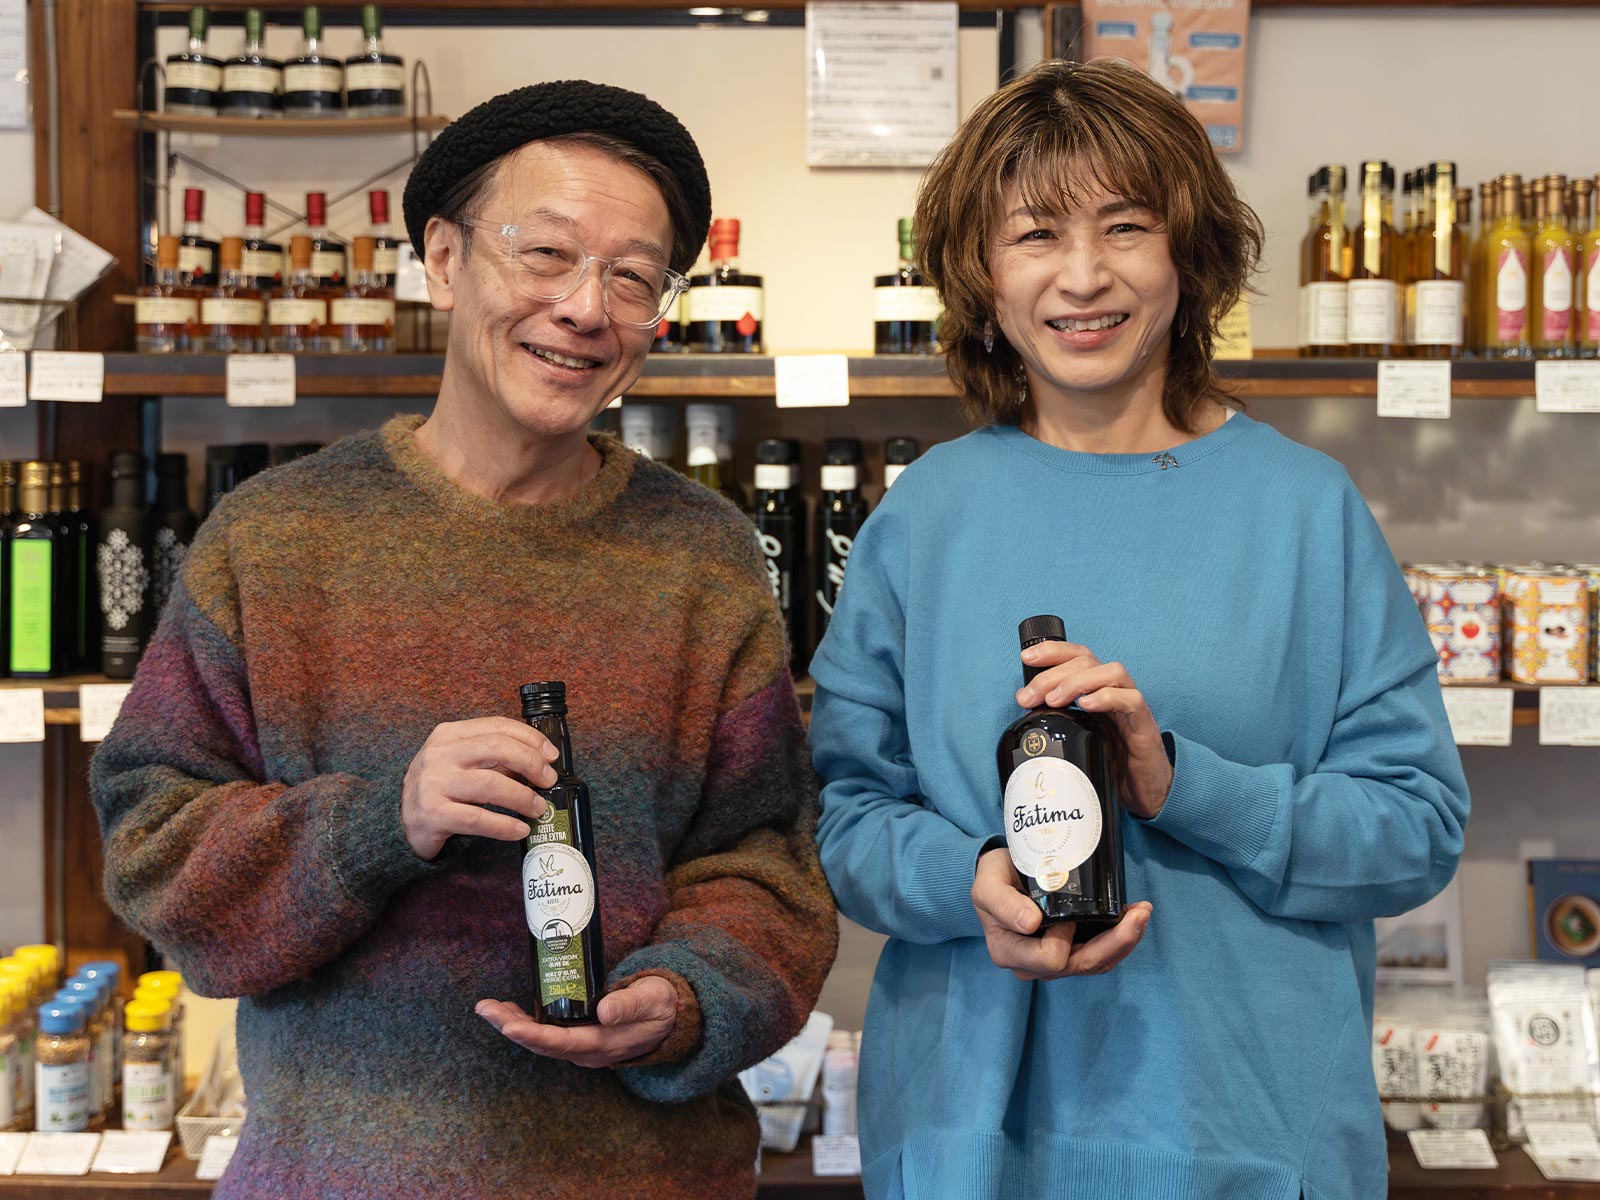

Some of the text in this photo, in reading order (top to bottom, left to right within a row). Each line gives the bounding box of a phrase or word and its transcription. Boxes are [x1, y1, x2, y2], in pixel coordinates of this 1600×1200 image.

[1013, 803, 1084, 832] Fátima
[538, 823, 555, 834] AZEITE
[549, 831, 567, 842] EXTRA
[528, 879, 583, 900] Fátima
